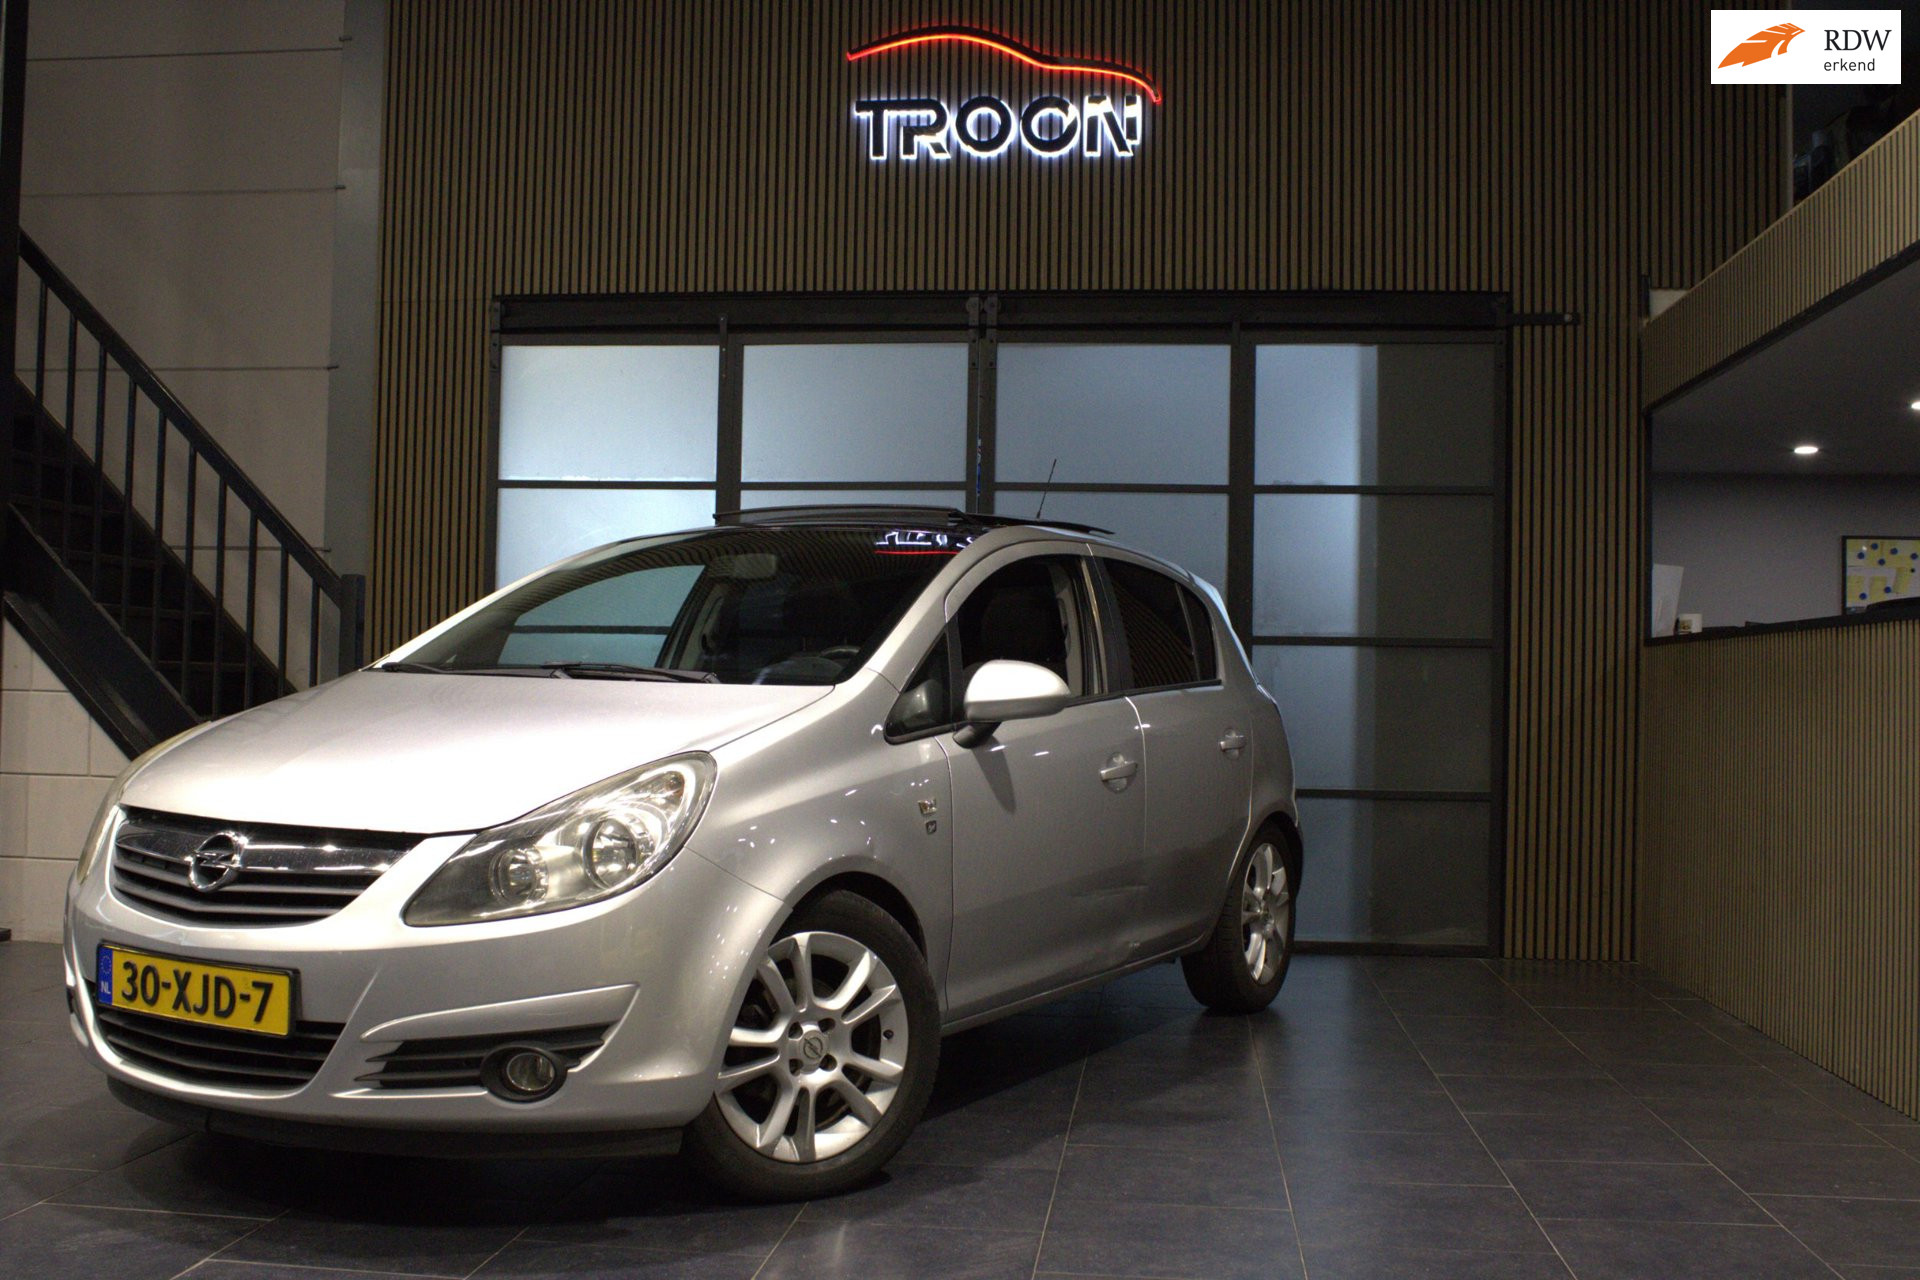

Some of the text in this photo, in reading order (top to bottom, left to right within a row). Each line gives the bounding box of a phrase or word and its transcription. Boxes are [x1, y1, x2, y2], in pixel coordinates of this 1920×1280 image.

[854, 95, 1141, 160] TROON
[101, 980, 111, 995] NL
[121, 960, 274, 1023] 30-XJD-7
